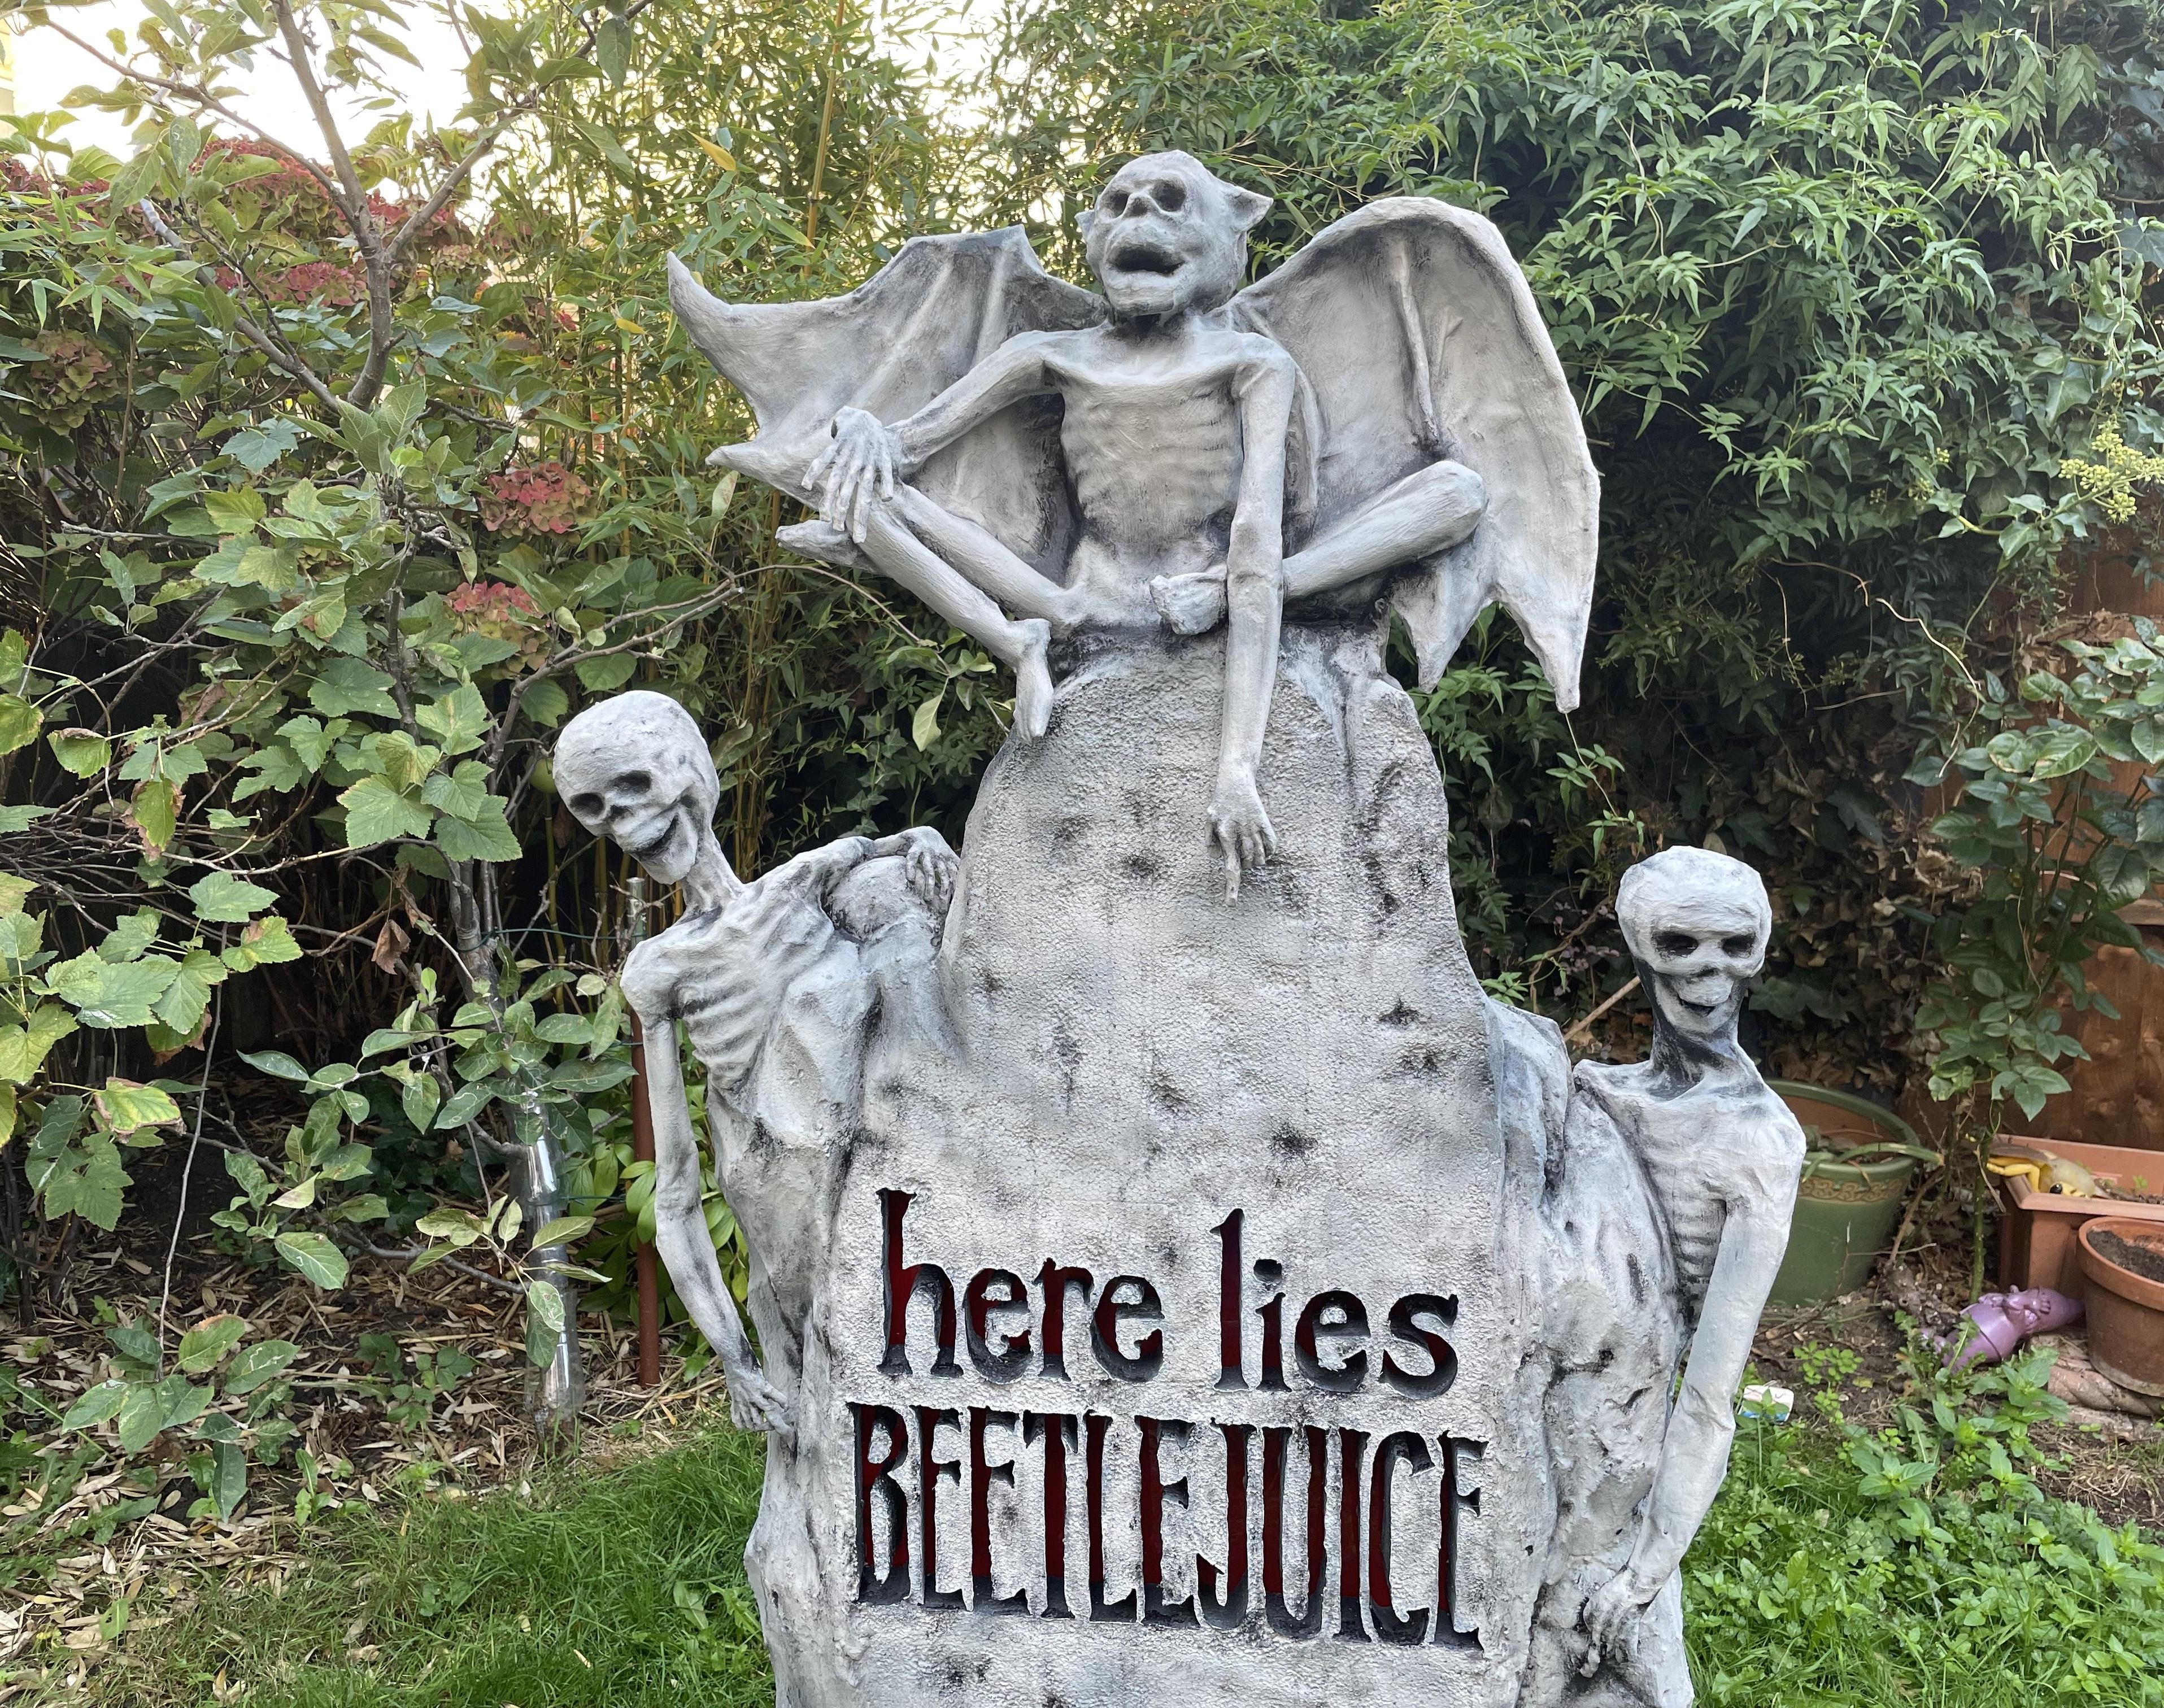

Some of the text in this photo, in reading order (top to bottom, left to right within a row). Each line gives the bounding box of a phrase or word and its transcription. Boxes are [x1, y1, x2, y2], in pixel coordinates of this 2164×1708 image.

[876, 1188, 1458, 1399] here lies
[846, 1402, 1489, 1650] BEETLEJUICE
